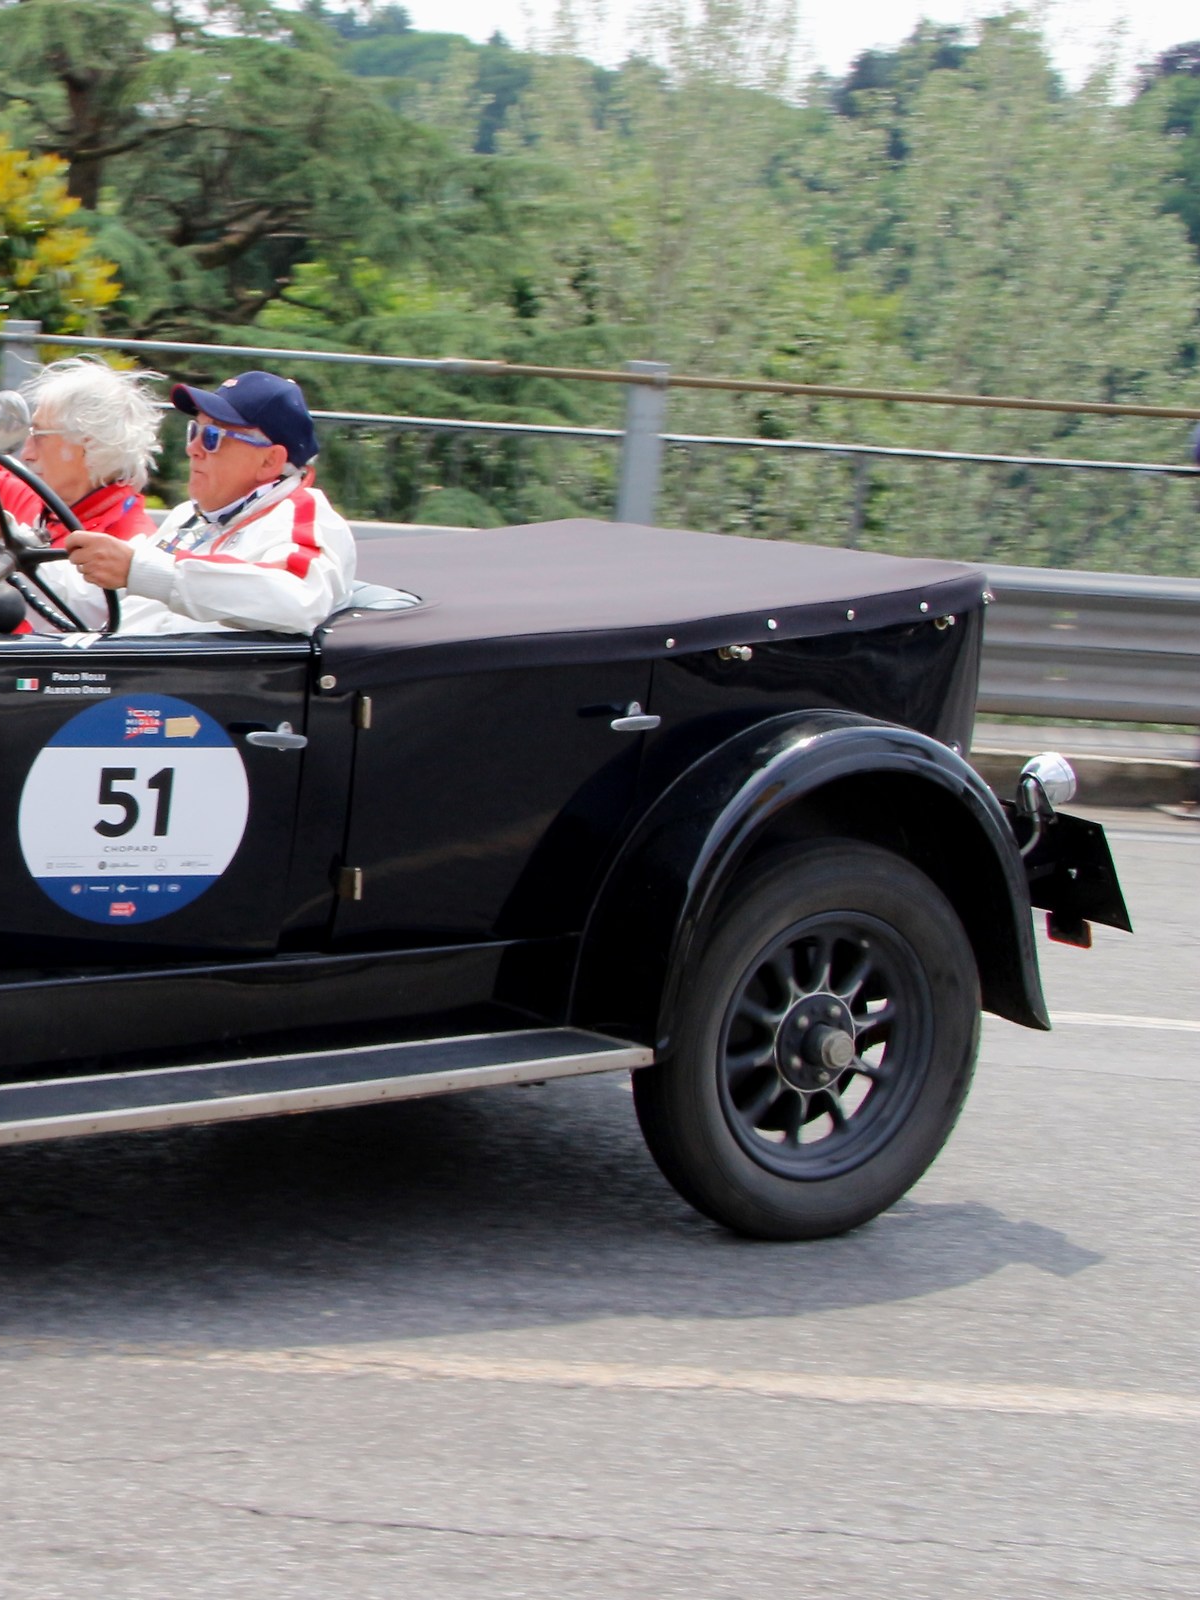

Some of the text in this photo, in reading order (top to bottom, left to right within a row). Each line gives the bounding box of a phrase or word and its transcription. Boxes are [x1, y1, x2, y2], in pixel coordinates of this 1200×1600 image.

[125, 718, 160, 726] MIGLIA
[94, 767, 175, 838] 51
[103, 845, 158, 853] CHOPARD
